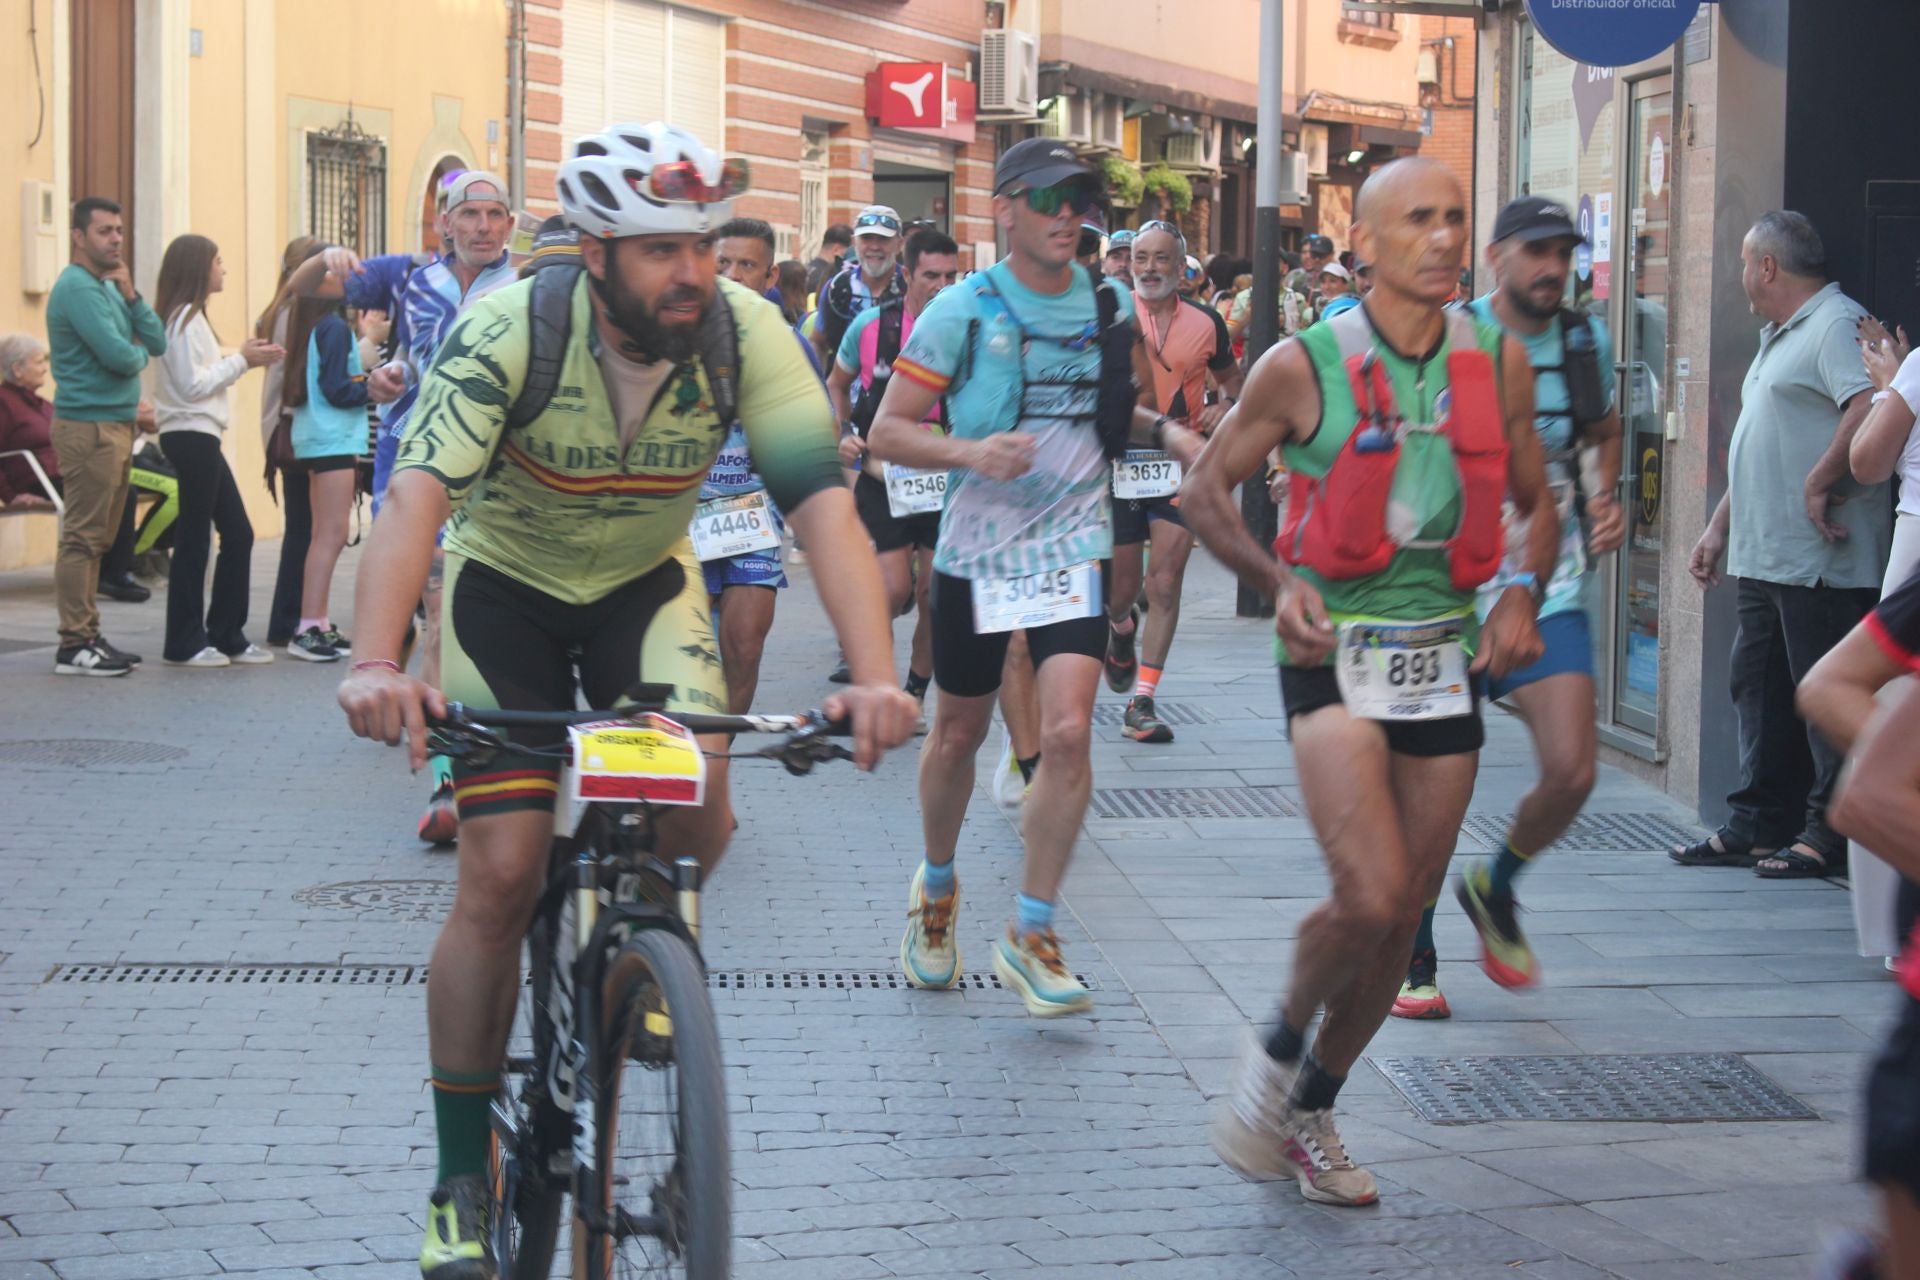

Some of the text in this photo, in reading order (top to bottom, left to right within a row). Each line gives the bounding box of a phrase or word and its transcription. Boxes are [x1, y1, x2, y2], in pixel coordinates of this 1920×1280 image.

[1552, 0, 1676, 9] Distribuidor oficial
[524, 436, 557, 464] LA
[903, 475, 946, 497] 2546
[1130, 463, 1172, 482] 3637
[709, 510, 760, 537] 4446
[1005, 569, 1071, 602] 3049
[1388, 649, 1441, 687] 893
